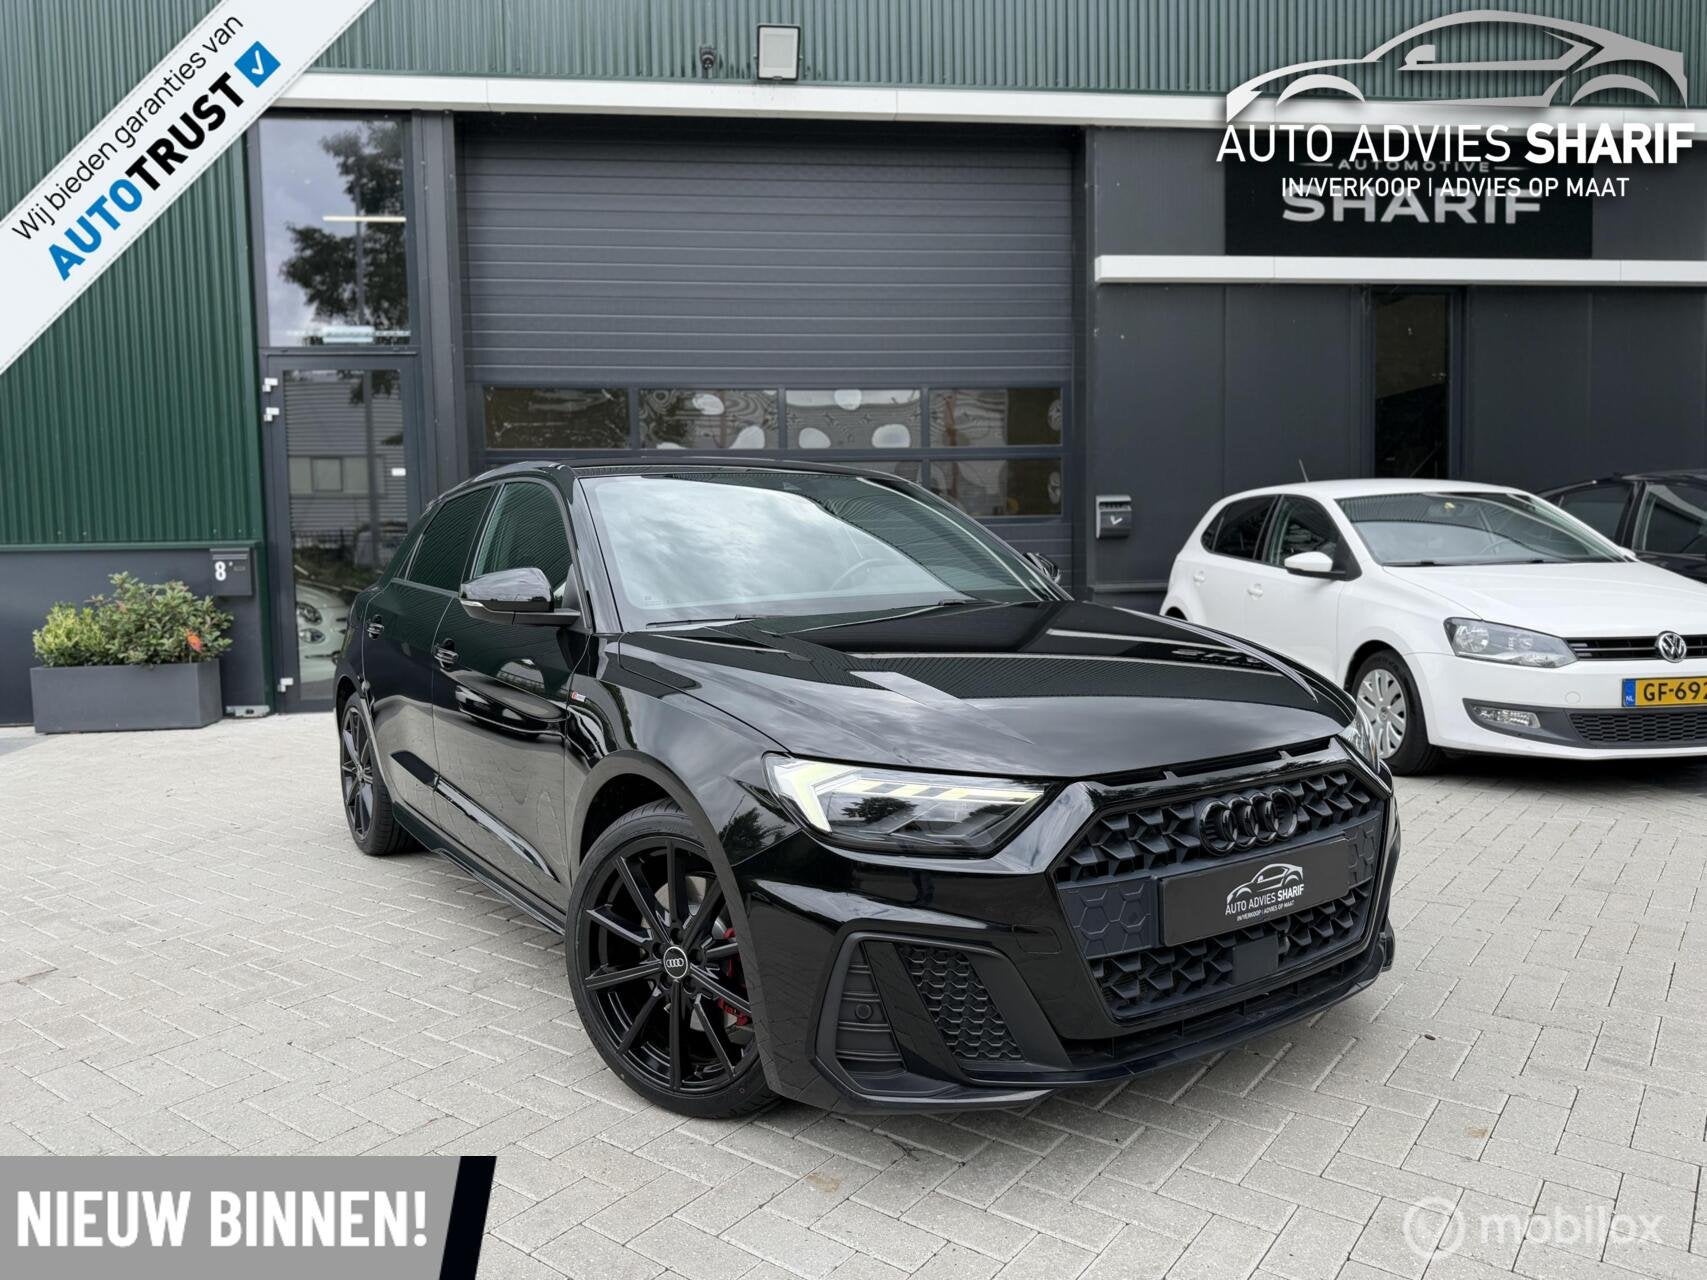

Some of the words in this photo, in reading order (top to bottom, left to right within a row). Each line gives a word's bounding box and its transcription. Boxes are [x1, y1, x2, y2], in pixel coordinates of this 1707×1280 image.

[1338, 158, 1490, 173] AUTOMOTIVE
[1282, 184, 1543, 224] SHARIF
[214, 561, 227, 581] 8
[1225, 900, 1247, 915] AUTO
[1248, 892, 1276, 910] ADVIES
[1277, 884, 1304, 902] SHARIF
